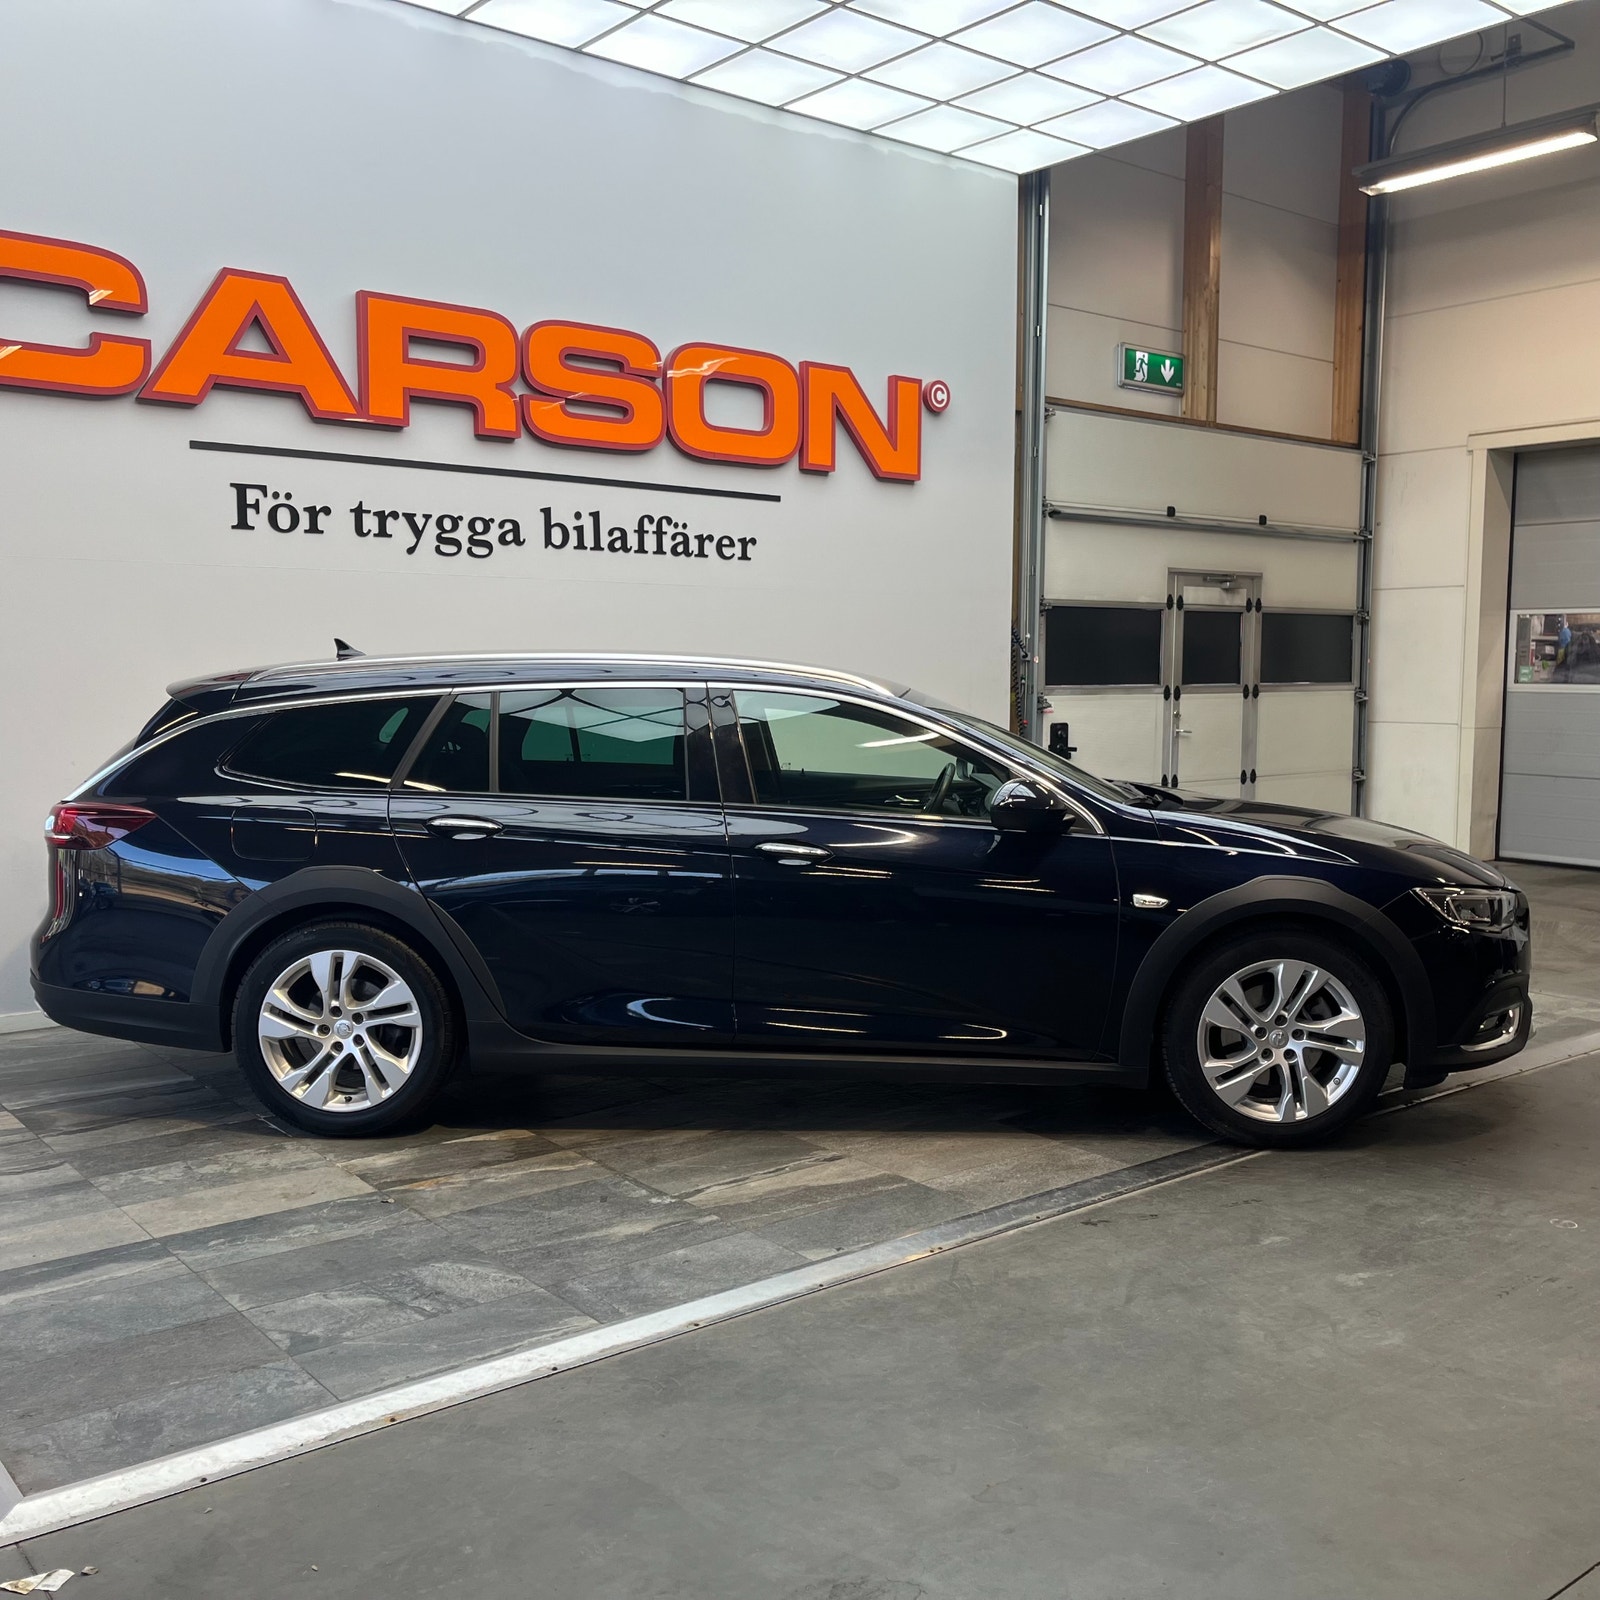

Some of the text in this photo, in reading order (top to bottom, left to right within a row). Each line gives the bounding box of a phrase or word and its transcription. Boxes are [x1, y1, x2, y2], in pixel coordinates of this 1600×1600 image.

[0, 229, 923, 483] CARSON
[229, 482, 758, 562] För trygga bilaffärer
